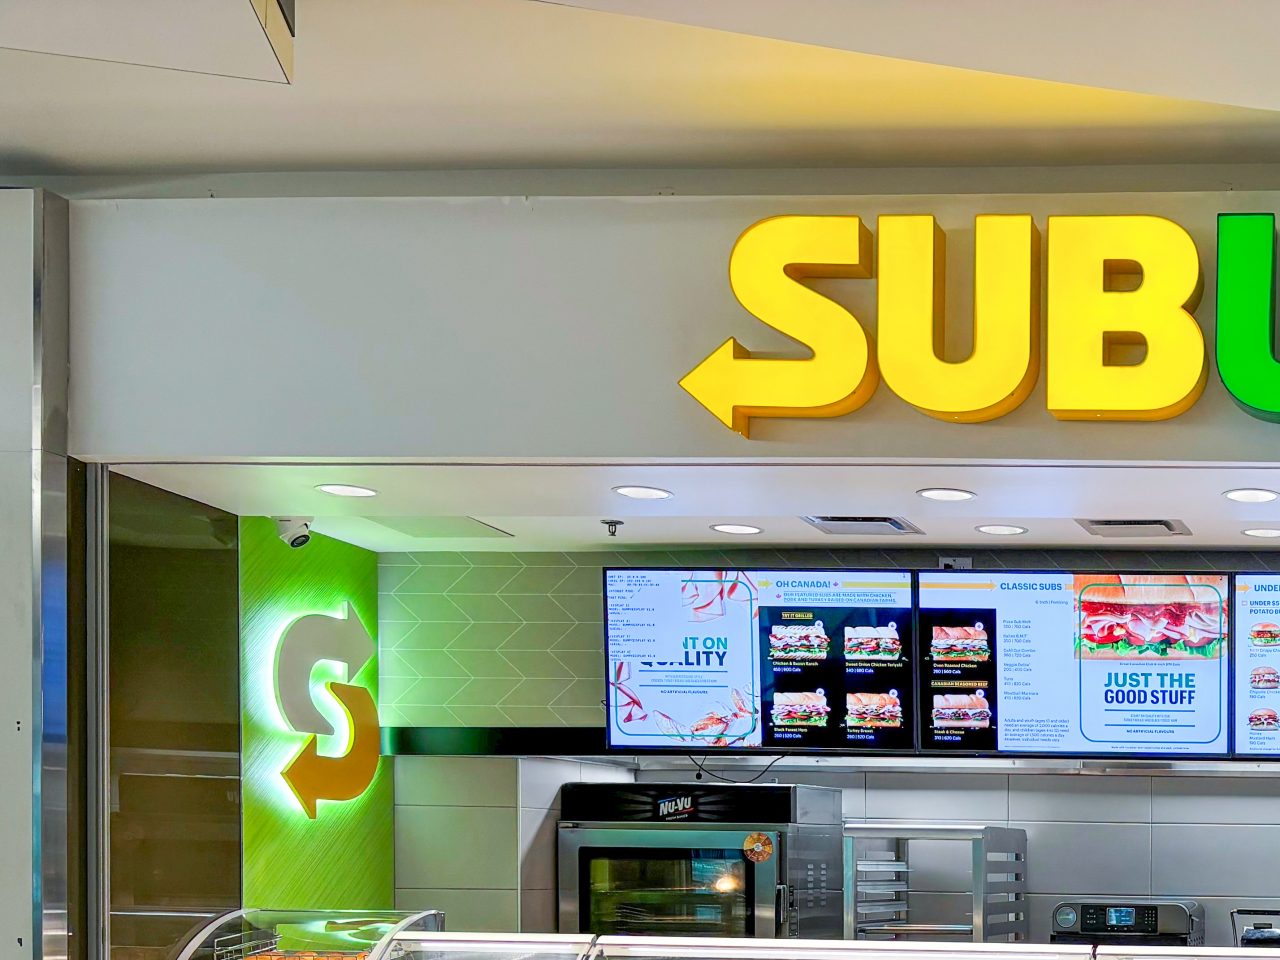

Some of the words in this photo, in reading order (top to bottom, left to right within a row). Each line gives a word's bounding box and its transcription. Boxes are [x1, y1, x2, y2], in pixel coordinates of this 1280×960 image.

[703, 637, 727, 649] ON
[1104, 673, 1152, 688] JUST
[1157, 673, 1195, 688] THE
[1104, 689, 1147, 704] GOOD
[1151, 690, 1195, 704] STUFF
